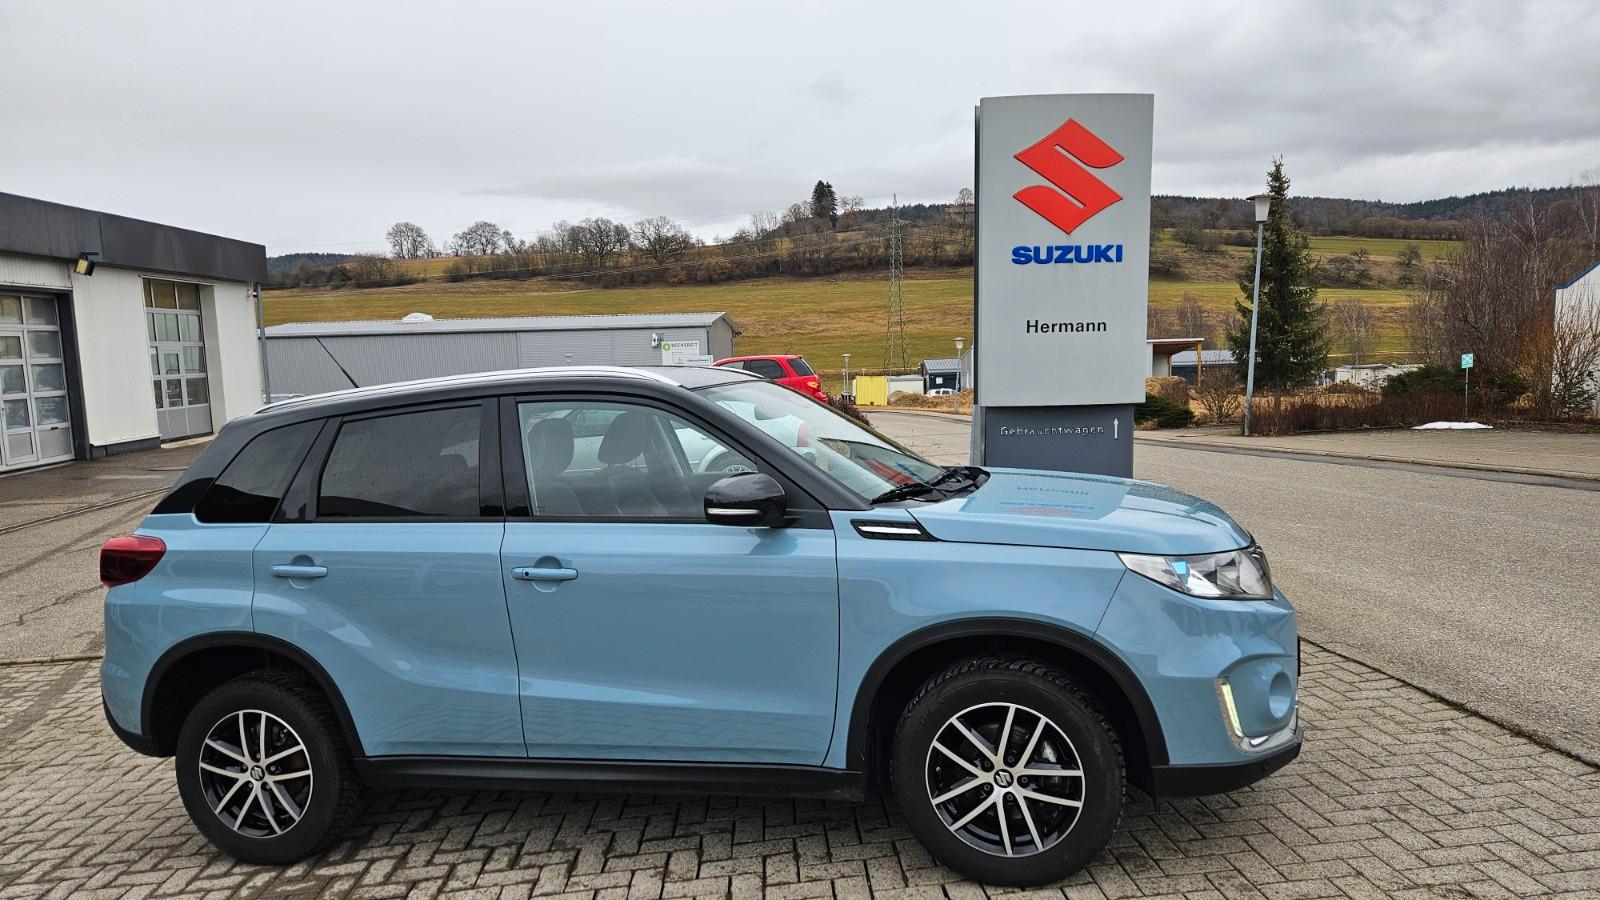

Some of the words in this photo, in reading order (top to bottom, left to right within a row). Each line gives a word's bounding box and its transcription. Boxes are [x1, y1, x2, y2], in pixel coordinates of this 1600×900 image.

[1011, 244, 1123, 265] SUZUKI
[1026, 319, 1107, 333] Hermann
[1000, 426, 1104, 436] Gebrauchtwagen
